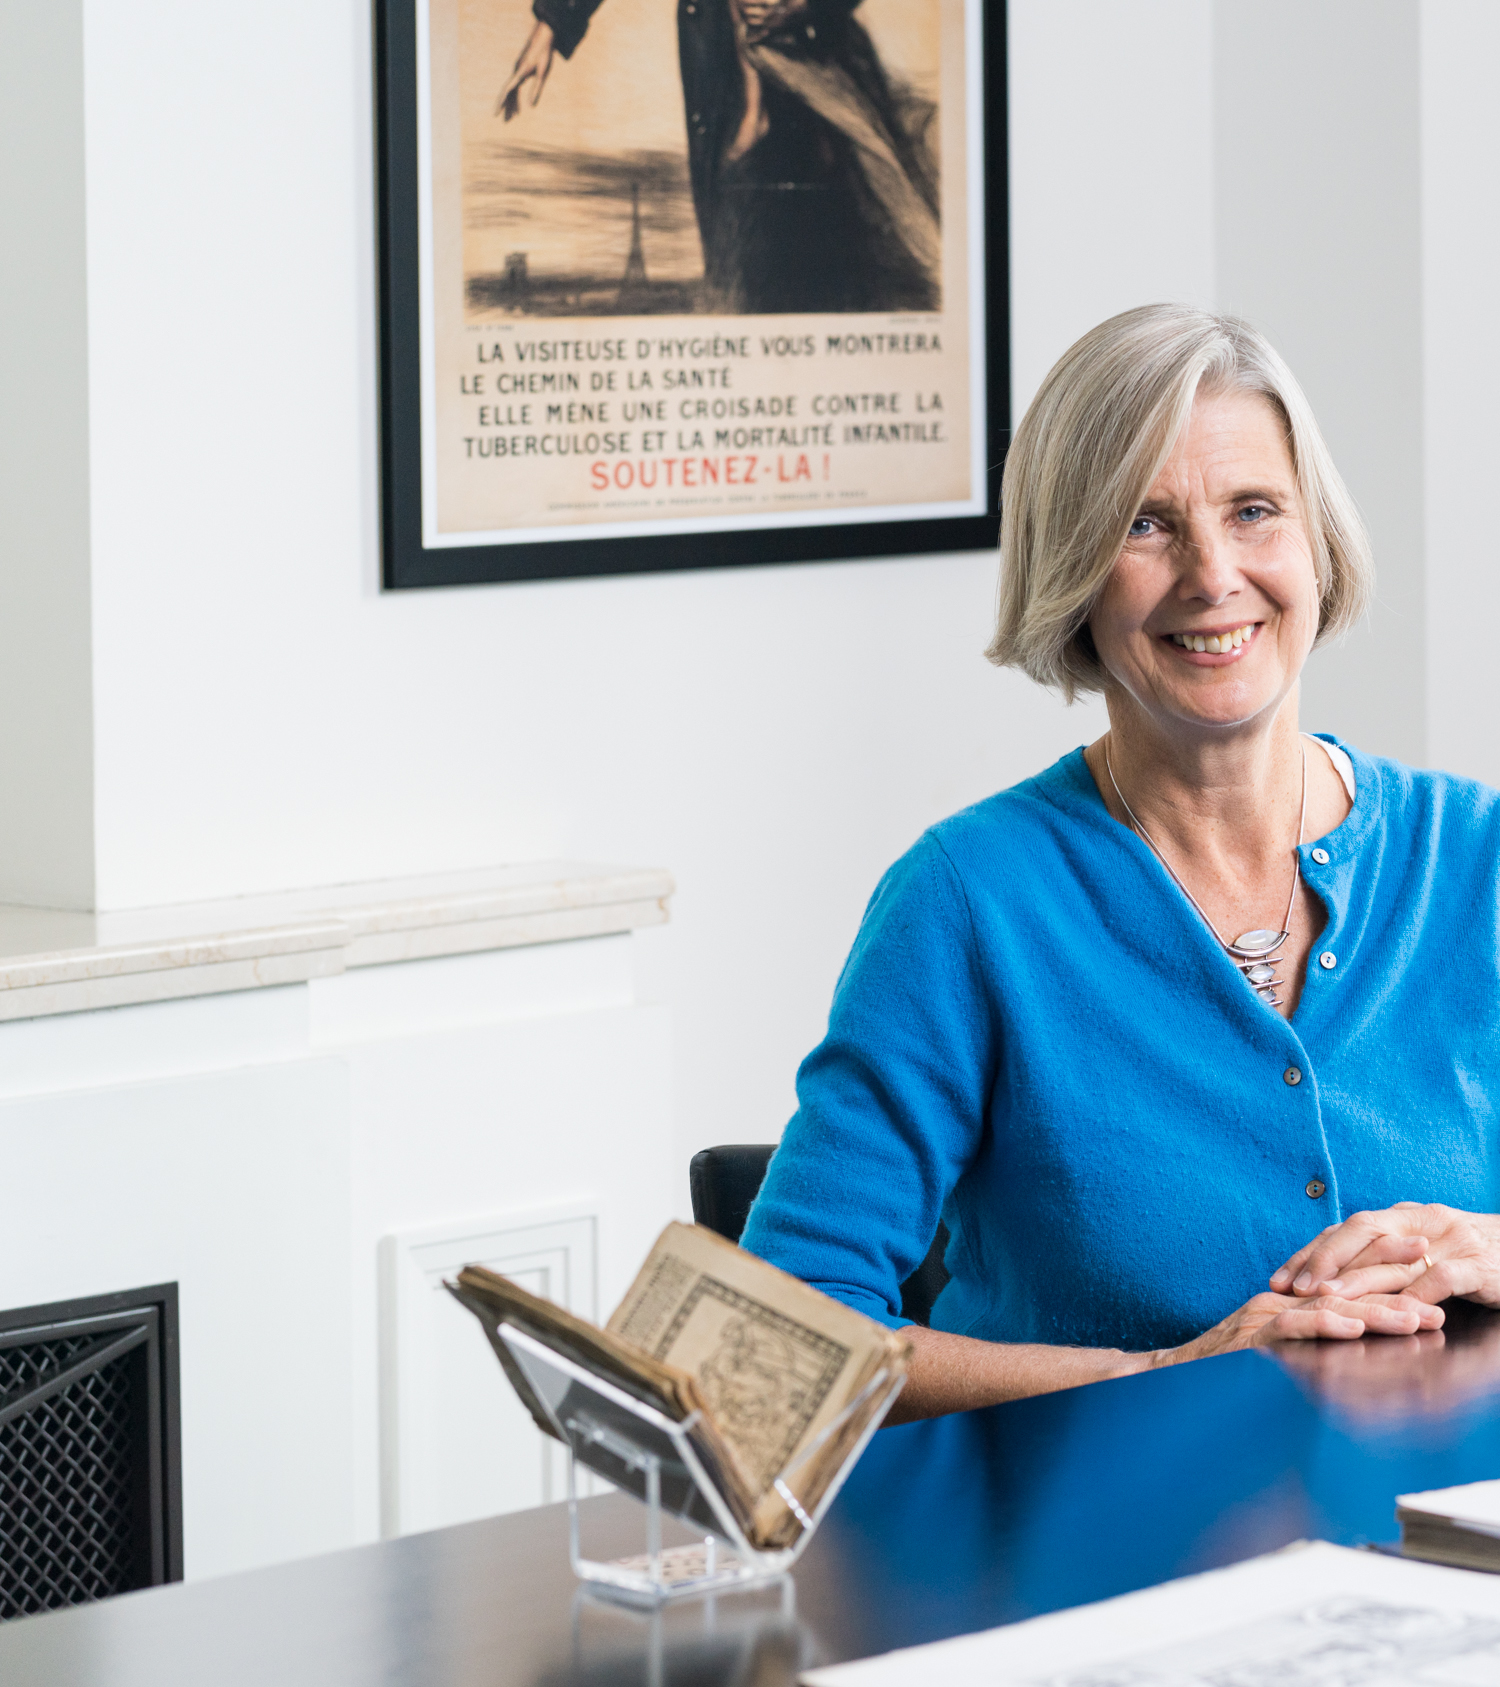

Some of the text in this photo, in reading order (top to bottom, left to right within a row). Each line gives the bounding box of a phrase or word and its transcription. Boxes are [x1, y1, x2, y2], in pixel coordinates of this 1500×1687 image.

[477, 331, 942, 364] LA VISITEUSE D'HYGIÈNE VOUS MONTRERA
[460, 366, 732, 395] LE CHEMIN DE LA SANTÉ
[478, 391, 943, 426] ELLE MÈNE UNE CROISADE CONTRE LA
[462, 421, 948, 459] TUBERCULOSE ET LA MORTALITÉ INFANTILE.
